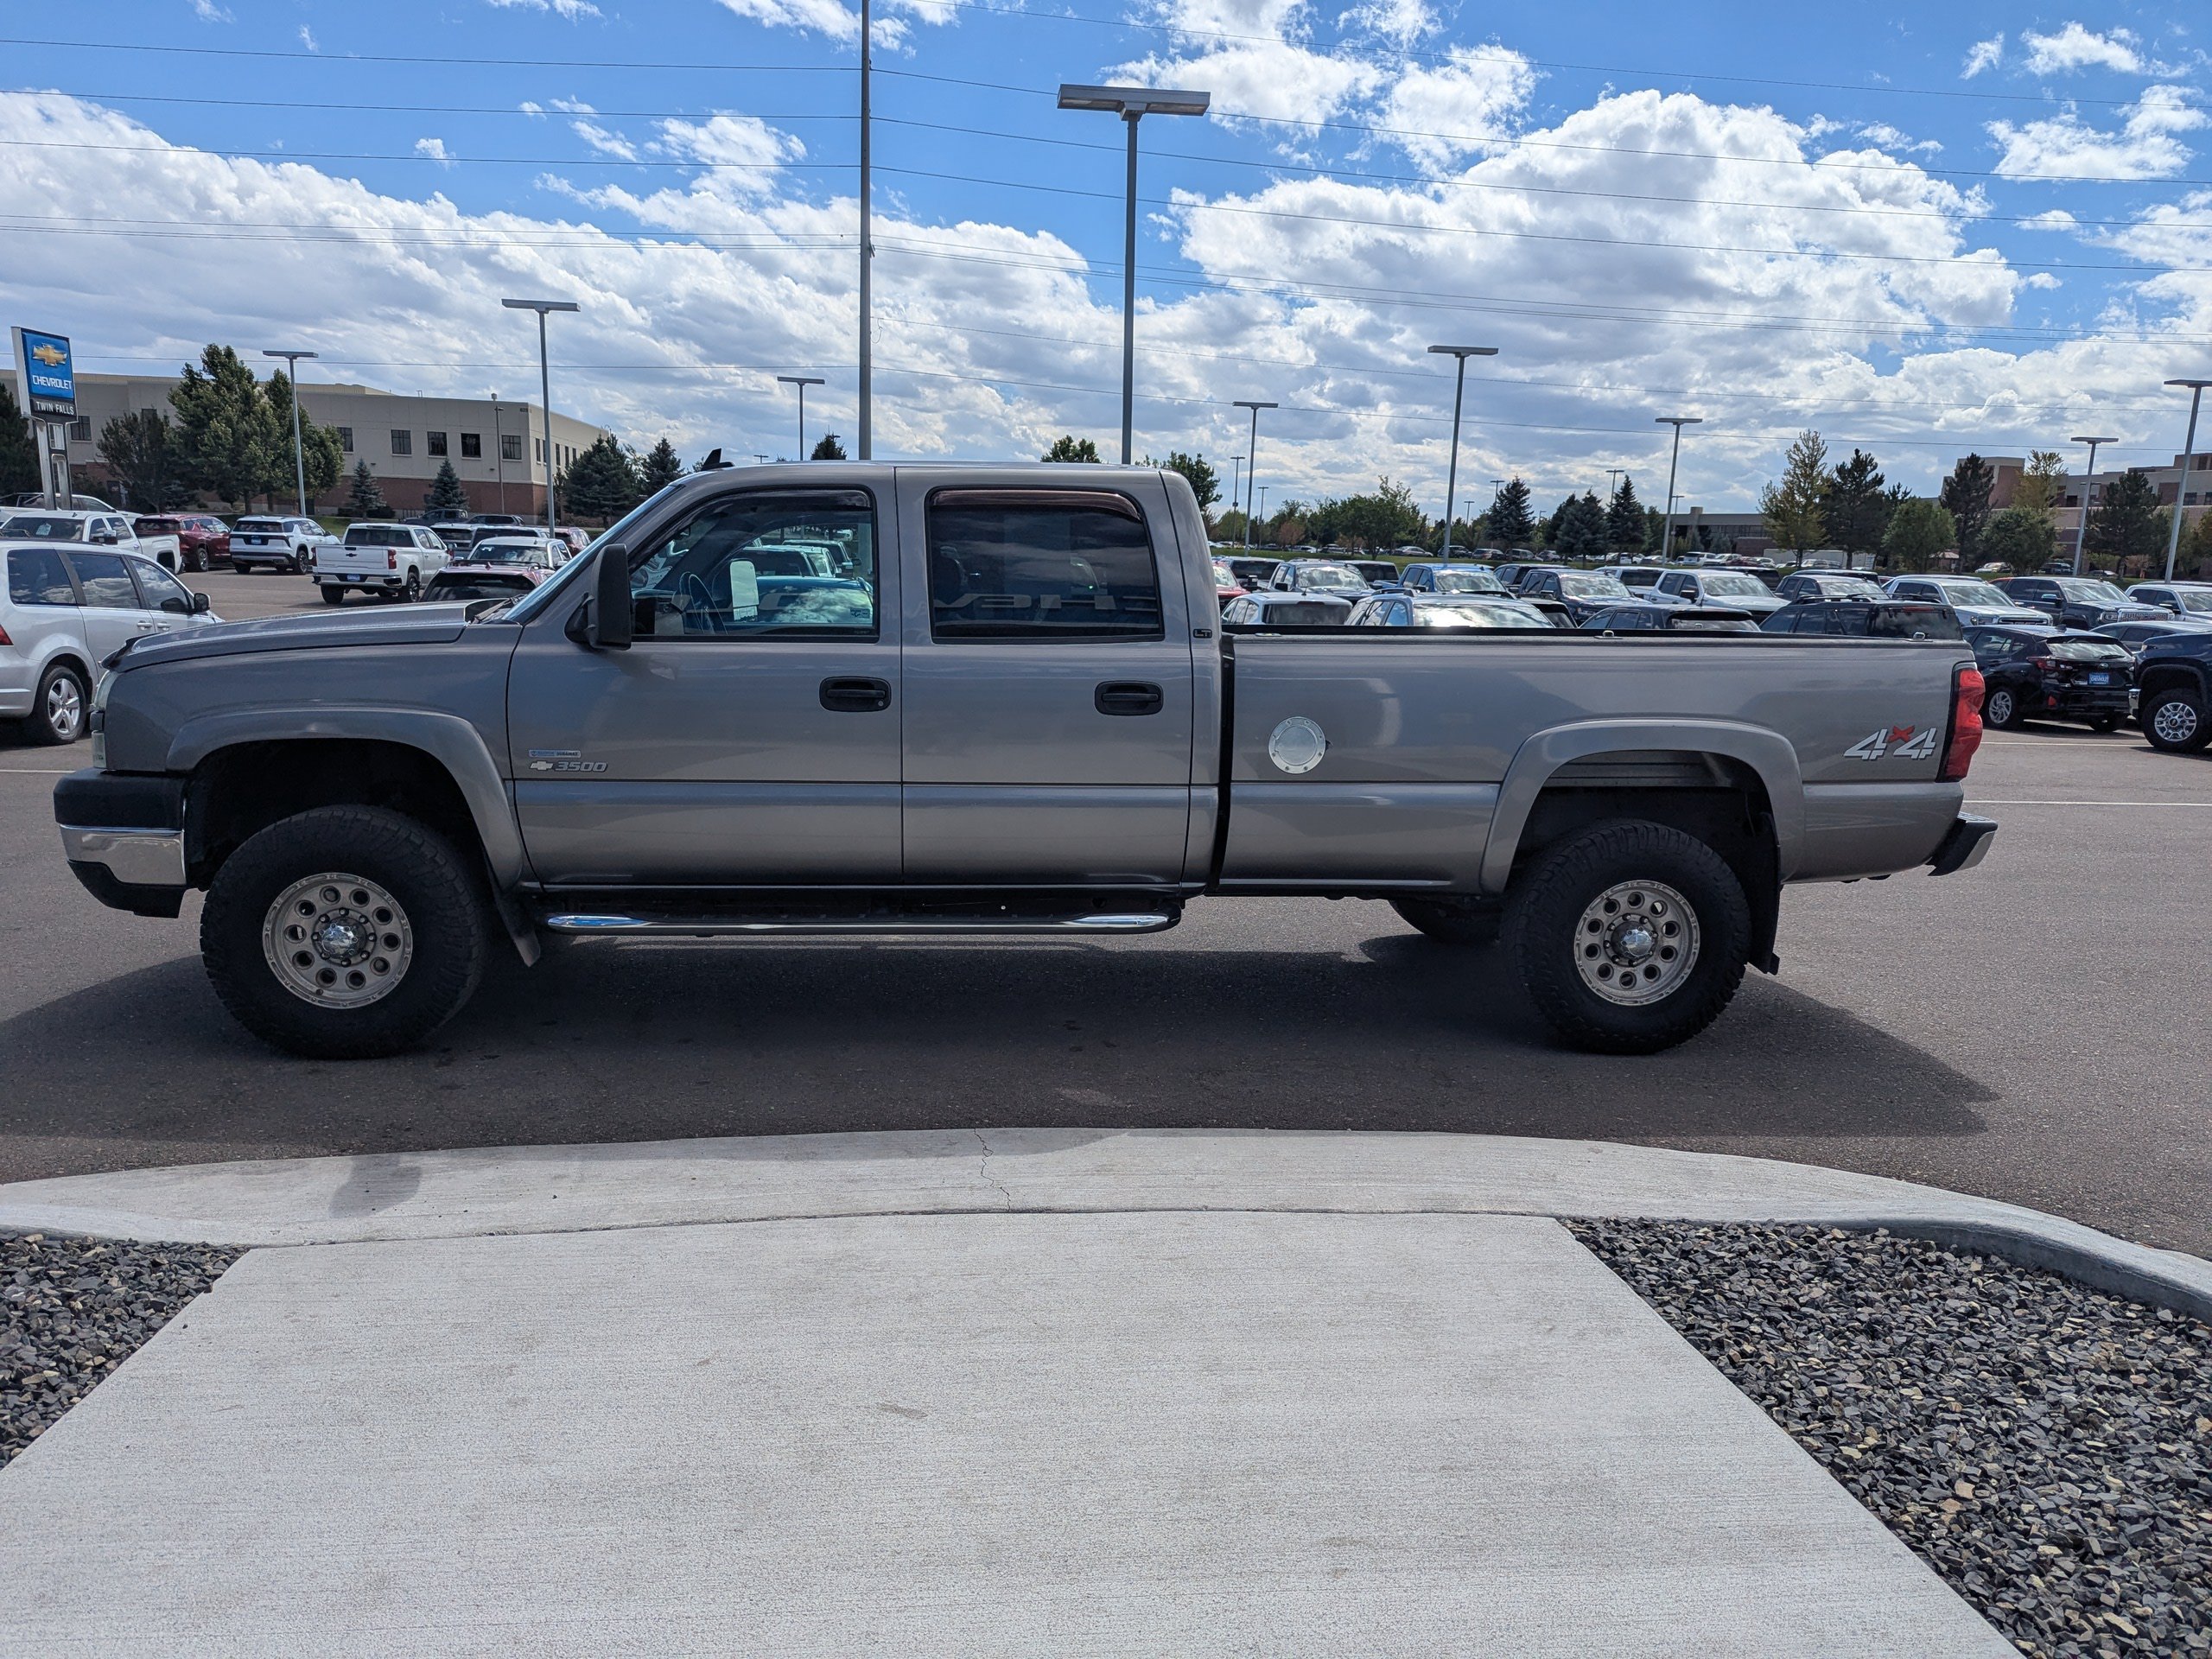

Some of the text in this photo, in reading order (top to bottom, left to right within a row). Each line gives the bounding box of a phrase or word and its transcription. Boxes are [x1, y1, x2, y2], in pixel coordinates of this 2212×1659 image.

[32, 375, 72, 389] CHEVROLET
[36, 402, 74, 415] TWIN FALLS
[555, 761, 608, 772] 3500
